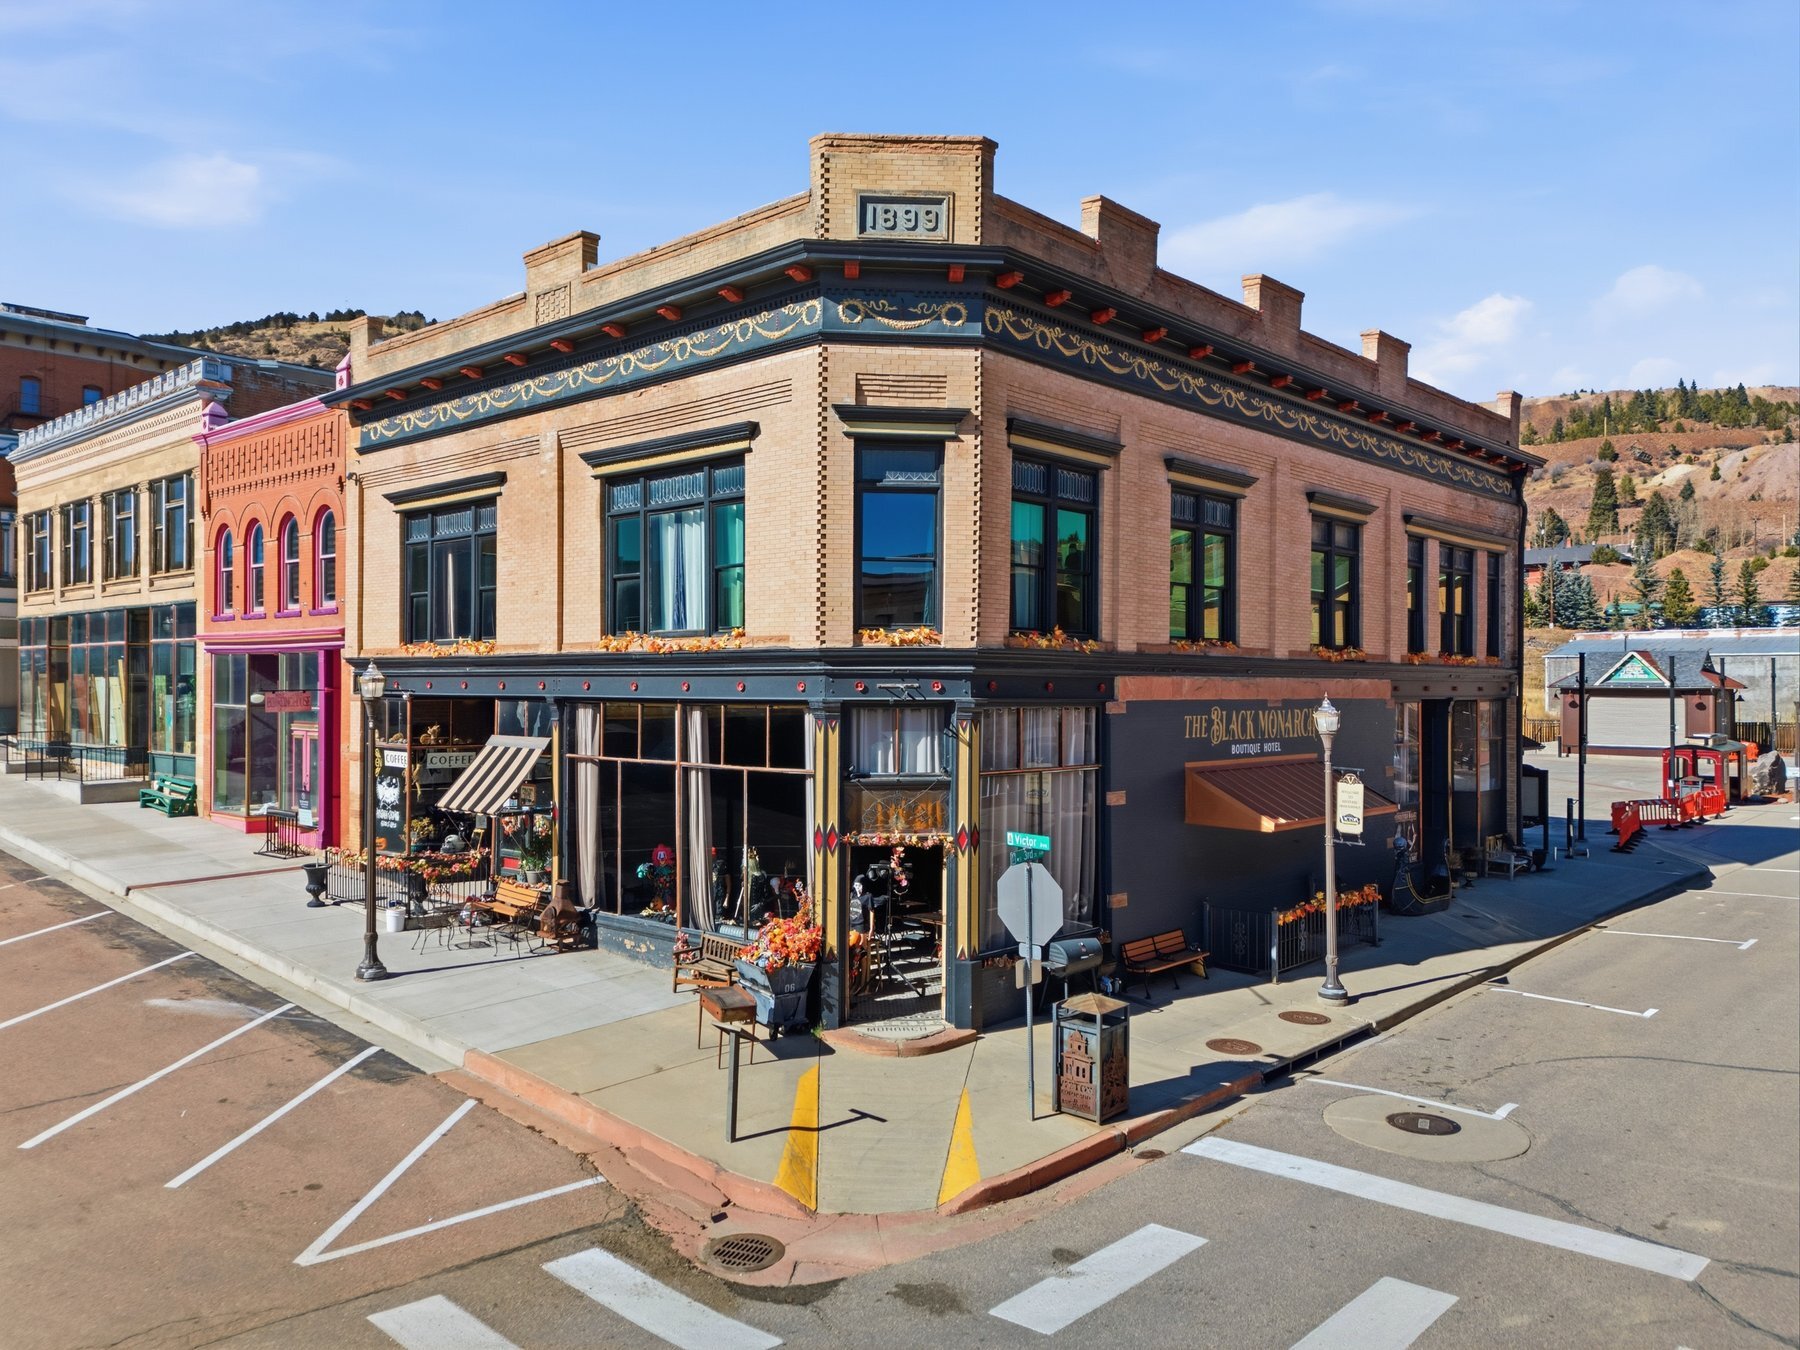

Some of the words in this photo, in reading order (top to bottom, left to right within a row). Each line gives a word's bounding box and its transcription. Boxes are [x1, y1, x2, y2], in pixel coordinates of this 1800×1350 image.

[867, 203, 938, 231] 1899
[1184, 715, 1208, 738] THE
[1211, 706, 1255, 745] BLACK
[1231, 743, 1261, 755] BOUTIQUE
[1263, 741, 1282, 752] HOTEL
[386, 754, 406, 765] COFFEE
[430, 755, 473, 765] COFFEE
[1014, 834, 1037, 847] Victor
[784, 983, 796, 993] 06
